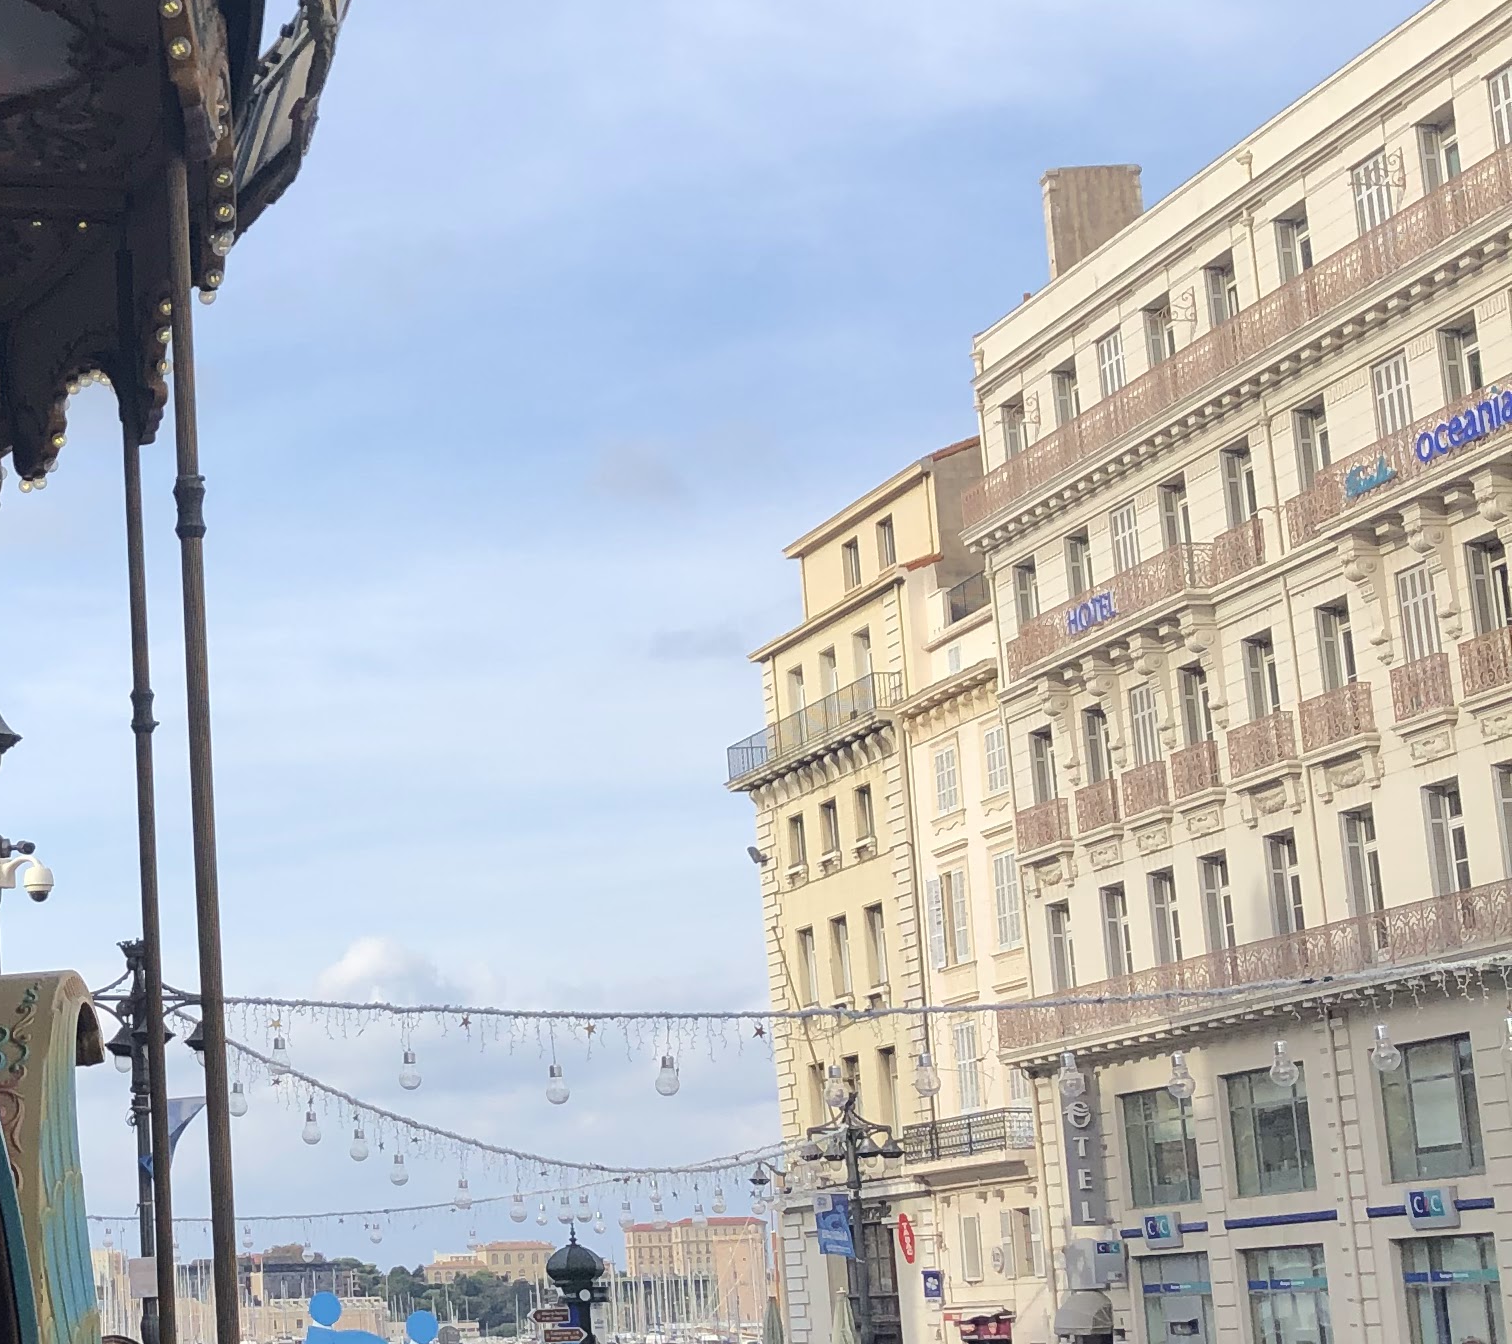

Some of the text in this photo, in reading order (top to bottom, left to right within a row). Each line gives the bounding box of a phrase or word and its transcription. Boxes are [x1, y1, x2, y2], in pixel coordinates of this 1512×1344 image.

[1416, 385, 1512, 463] oceania
[1067, 590, 1117, 635] HOTEL
[1063, 1100, 1096, 1223] OTEL
[1413, 1194, 1442, 1214] CIC
[1147, 1218, 1171, 1237] CIC
[1098, 1242, 1120, 1254] CIC
